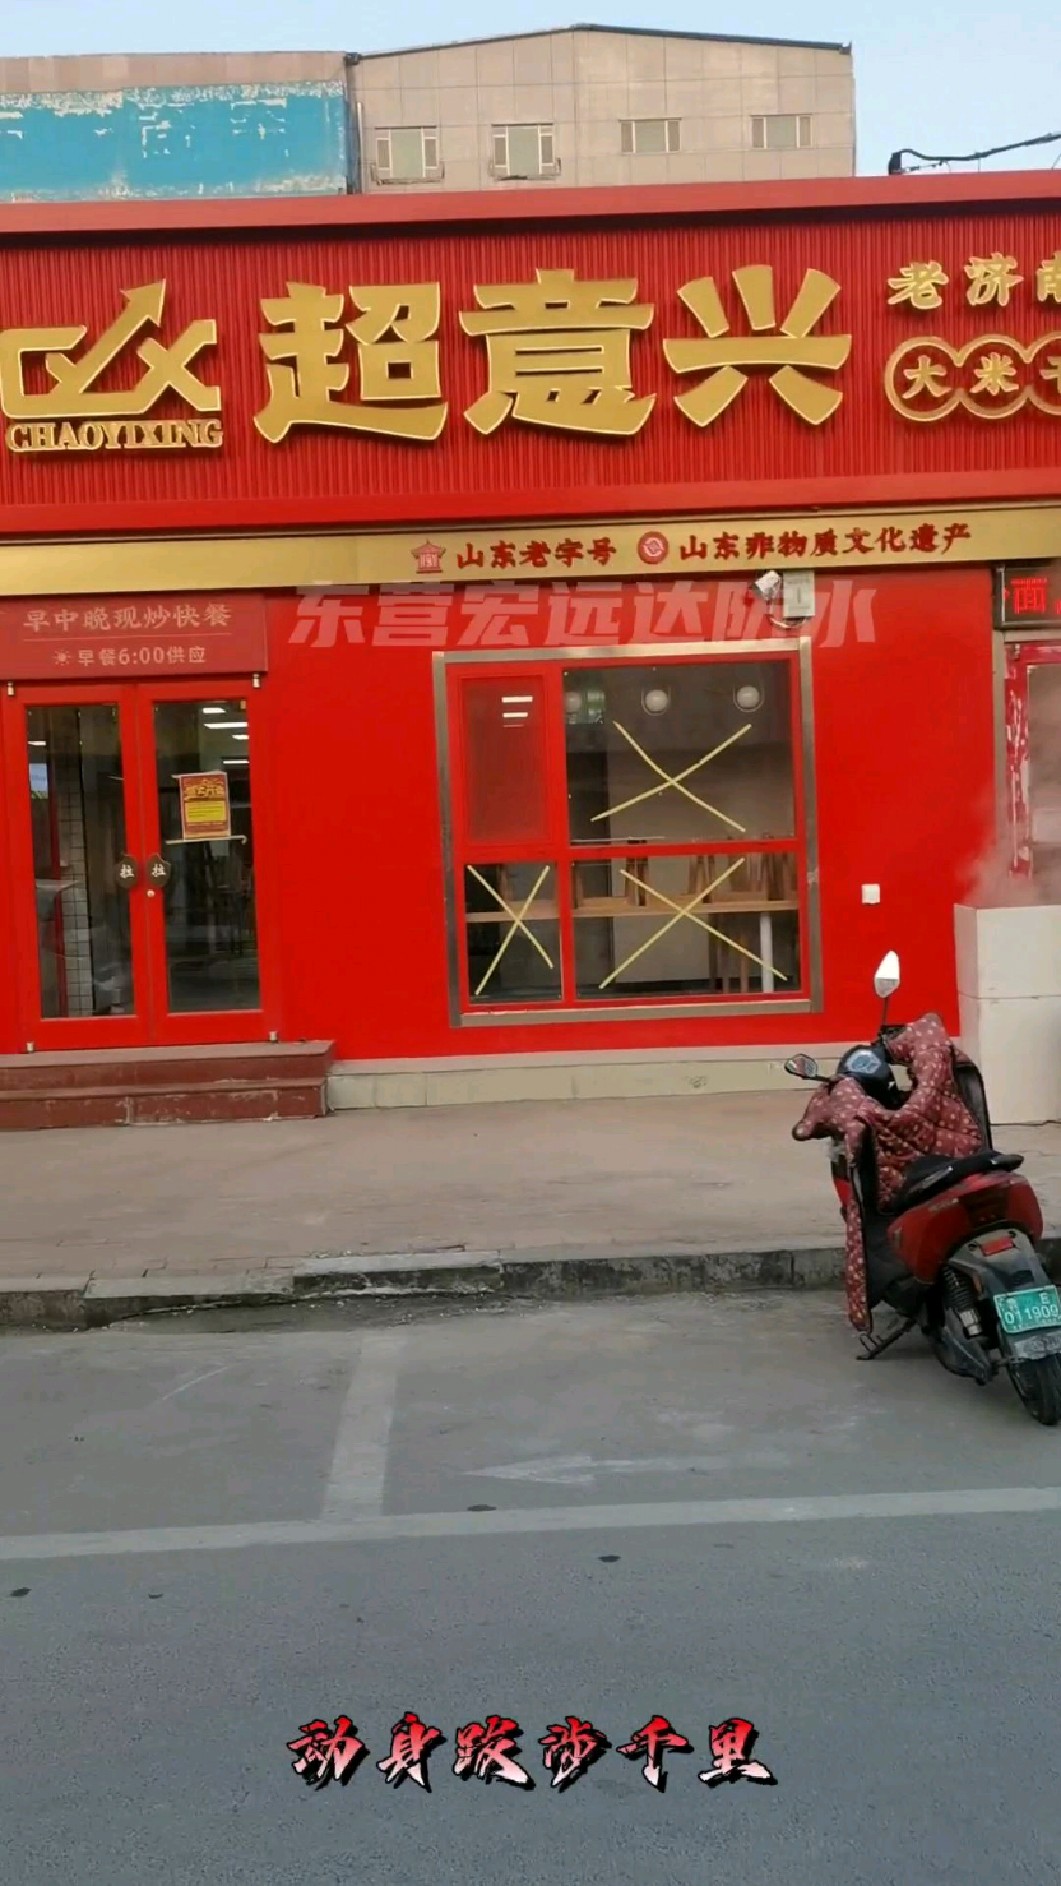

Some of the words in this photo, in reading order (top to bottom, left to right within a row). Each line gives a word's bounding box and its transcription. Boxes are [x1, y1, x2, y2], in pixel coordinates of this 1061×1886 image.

[253, 264, 852, 444] 超意兴
[6, 419, 224, 452] CHAOYIXING
[457, 536, 616, 570] 山东老字号
[679, 522, 970, 560] 山东非物质文化遗产
[1009, 577, 1061, 615] 面
[23, 603, 233, 632] 早中晚现炒快餐
[78, 645, 206, 667] 早餐6:00供应
